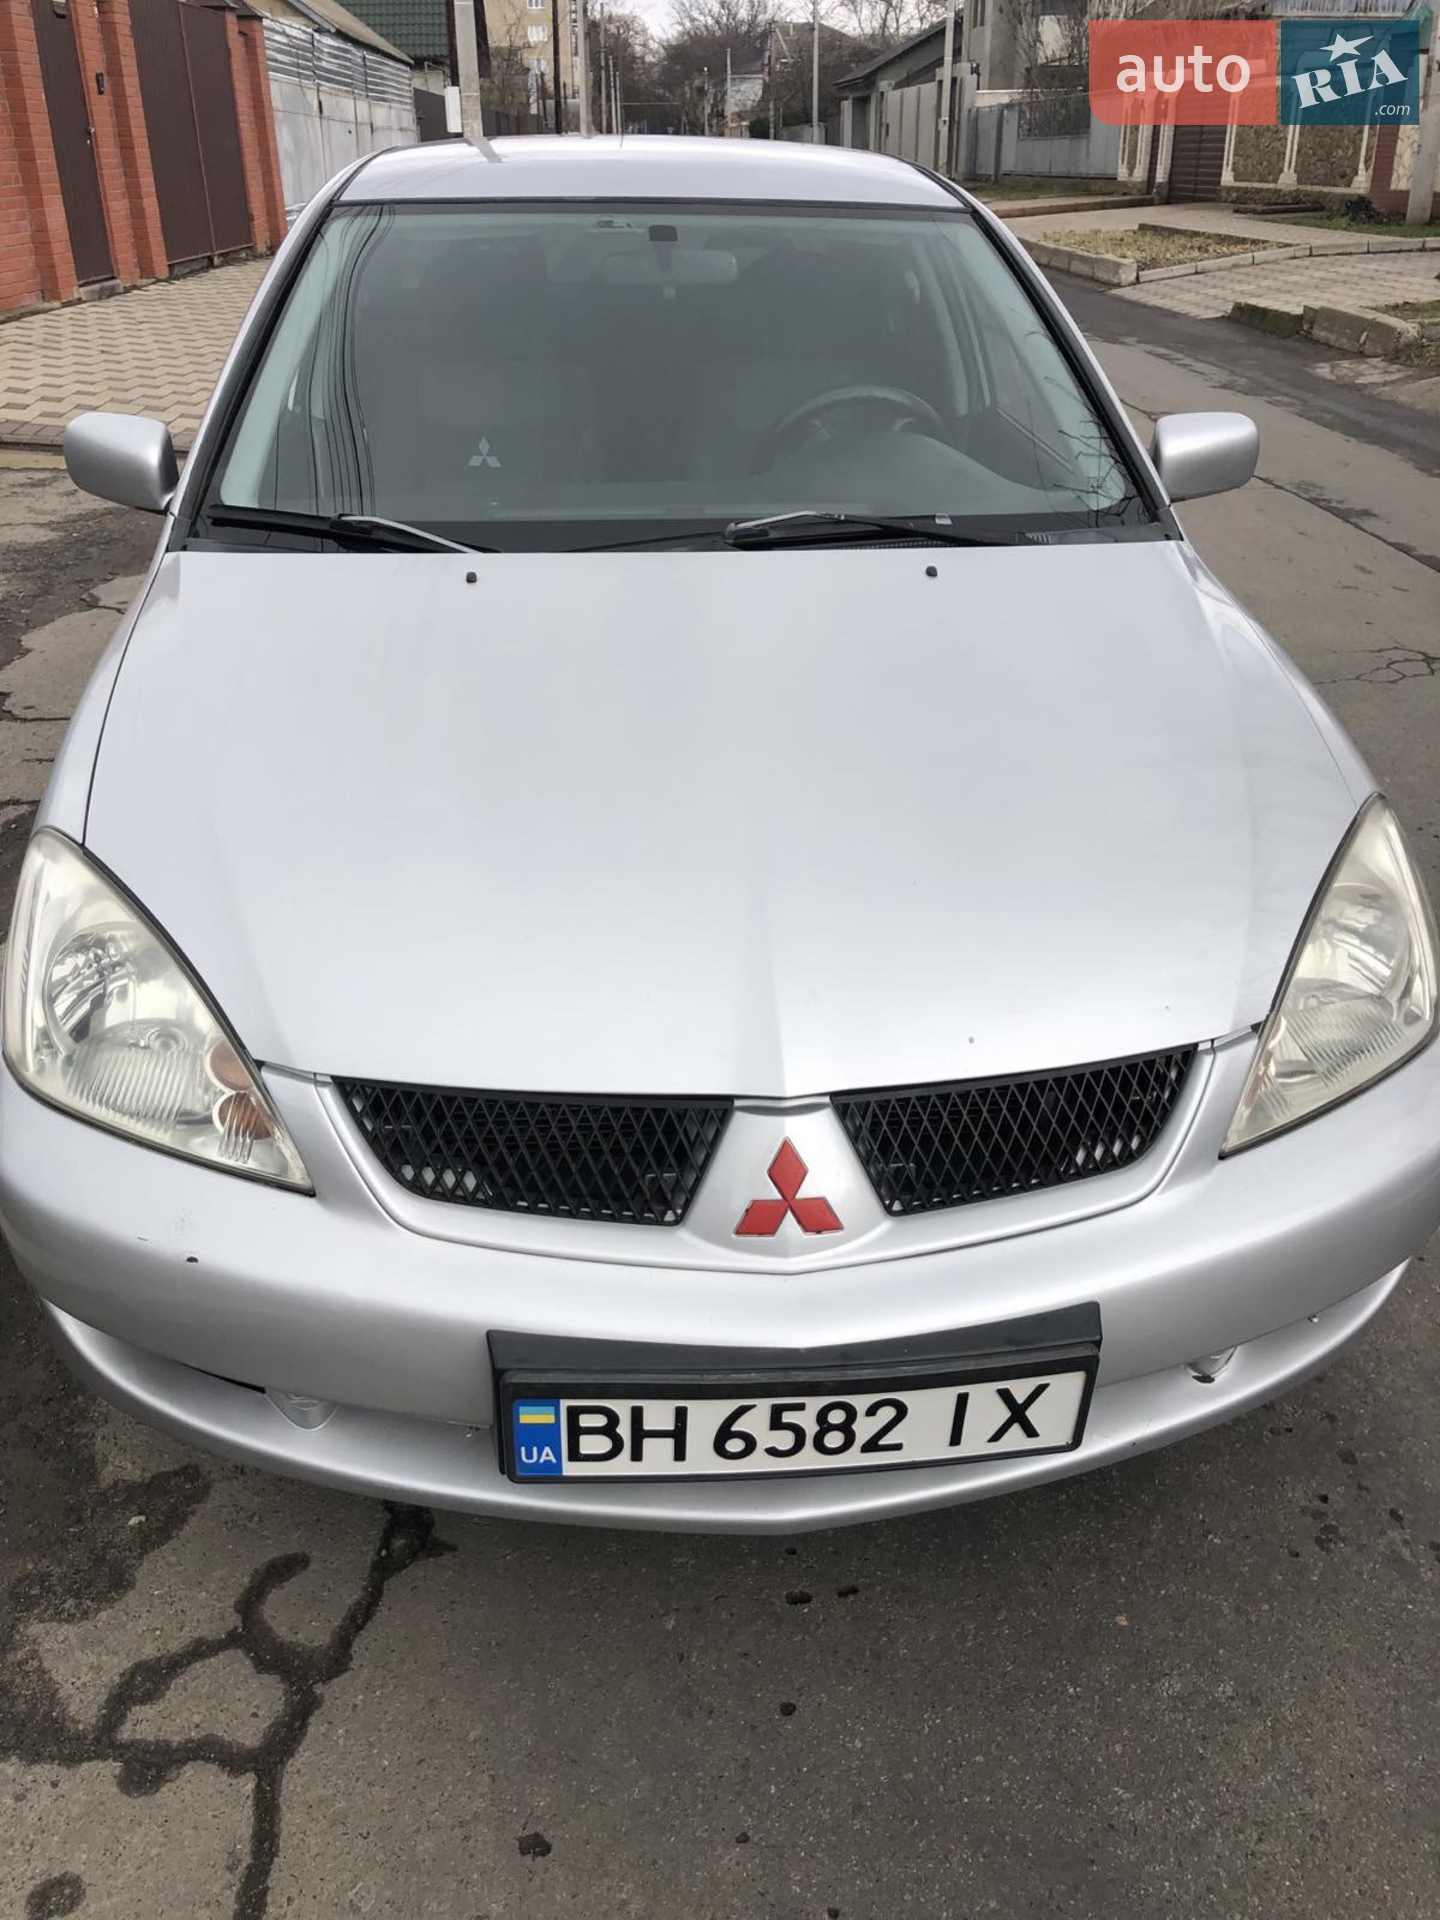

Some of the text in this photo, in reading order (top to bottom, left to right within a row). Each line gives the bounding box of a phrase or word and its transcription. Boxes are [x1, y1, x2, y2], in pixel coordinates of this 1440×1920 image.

[566, 1382, 1051, 1462] BH 6582 IX
[520, 1446, 557, 1465] UA
